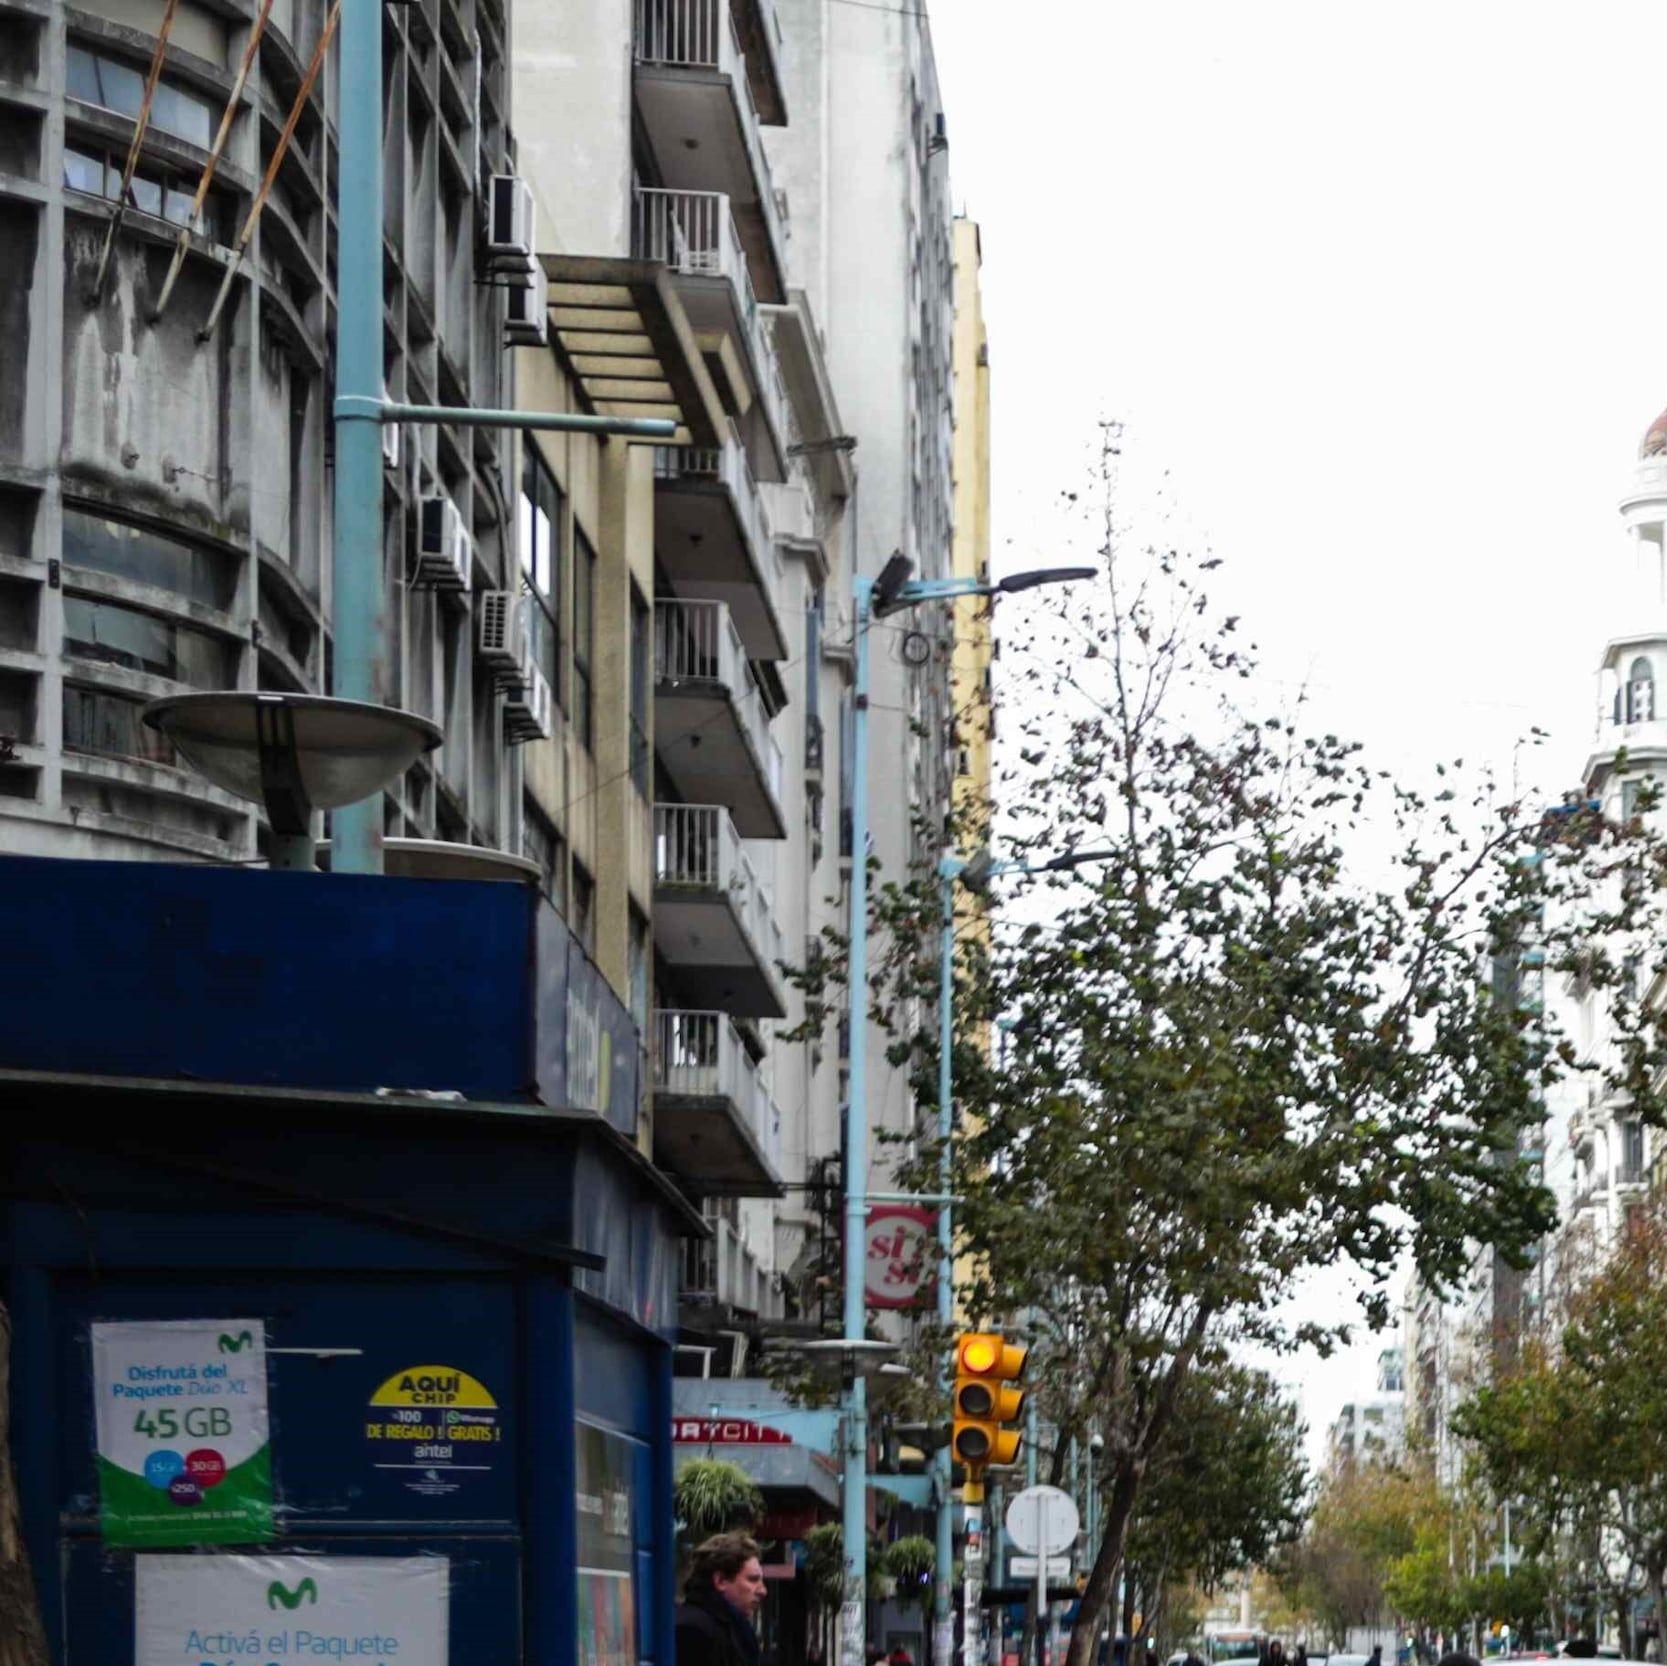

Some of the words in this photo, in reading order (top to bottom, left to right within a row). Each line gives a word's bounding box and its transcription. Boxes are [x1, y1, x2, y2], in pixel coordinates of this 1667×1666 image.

[202, 1363, 227, 1379] del
[113, 1383, 184, 1400] Paquete
[411, 1392, 456, 1404] CHIP
[134, 1409, 178, 1439] 45
[185, 1407, 232, 1438] GB
[367, 1424, 382, 1438] DE
[385, 1424, 434, 1439] REGALO
[448, 1425, 493, 1441] GRATIS
[414, 1445, 453, 1458] antel
[185, 1629, 261, 1655] Activá
[267, 1631, 288, 1655] el
[295, 1630, 400, 1662] Paquete
